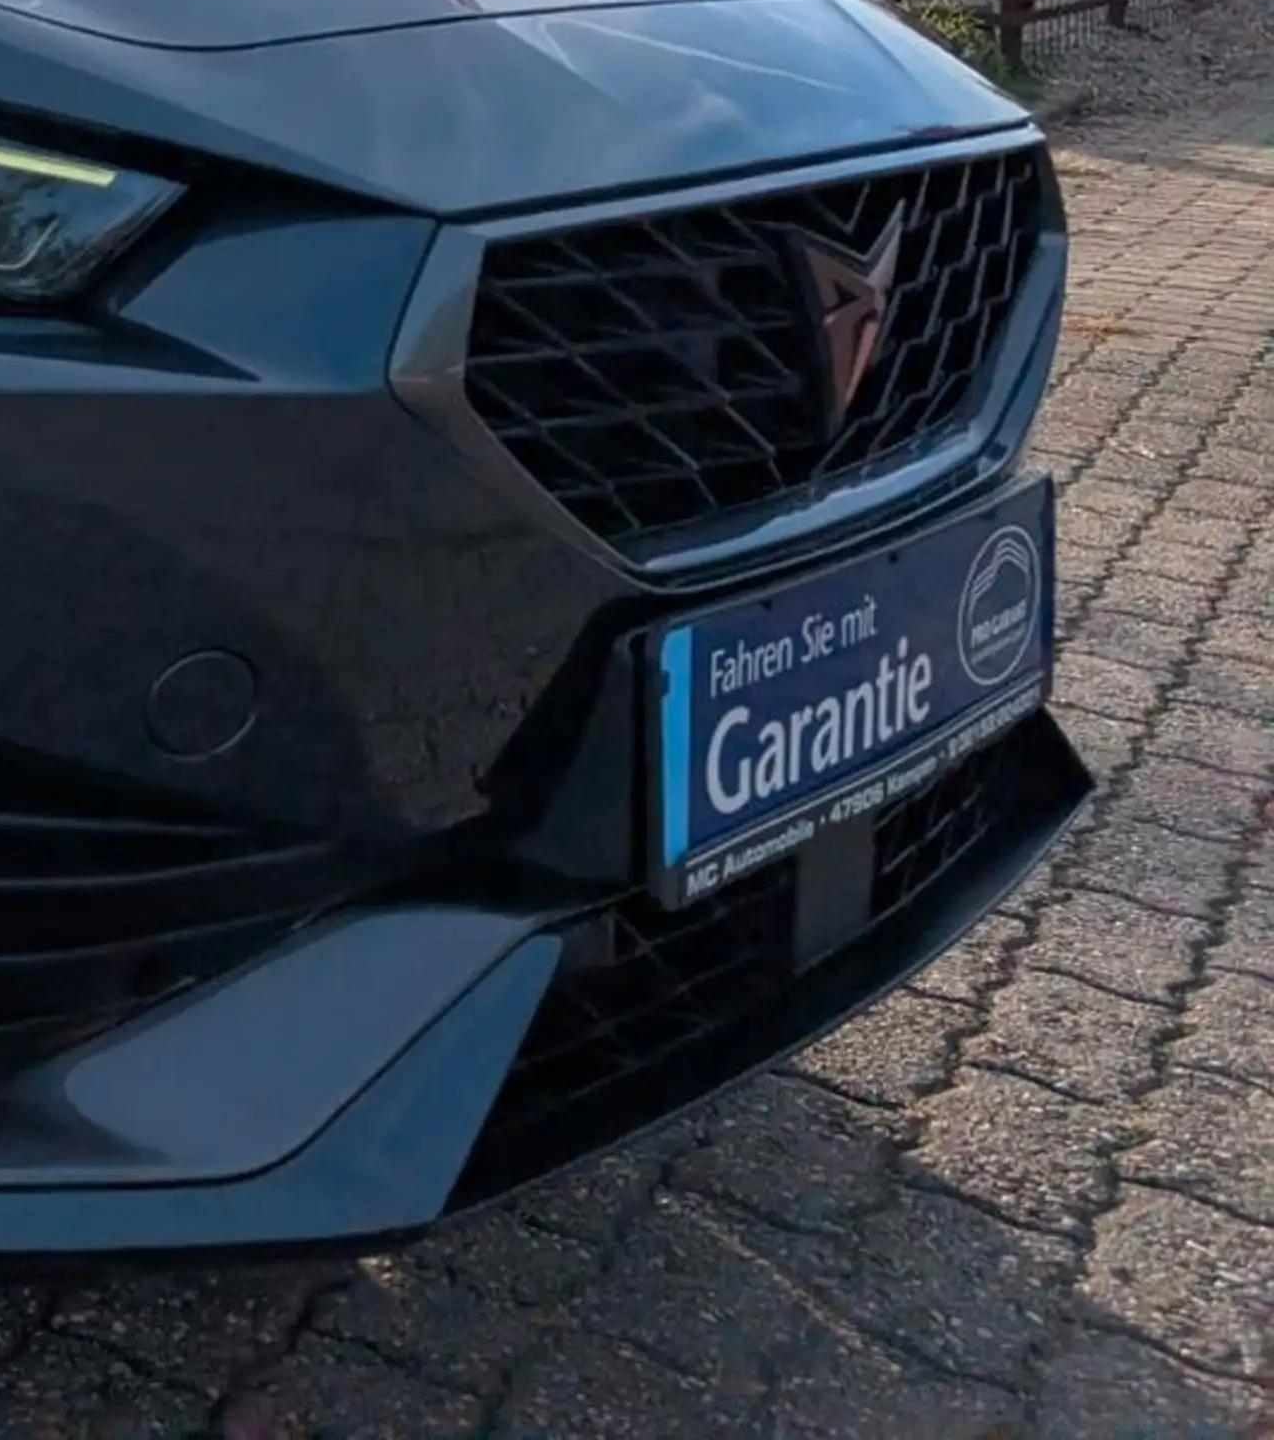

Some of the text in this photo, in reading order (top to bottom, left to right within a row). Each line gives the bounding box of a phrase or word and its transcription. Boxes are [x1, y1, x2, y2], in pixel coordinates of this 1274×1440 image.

[710, 592, 879, 700] Fahren Sie mit
[705, 634, 933, 815] Garantie
